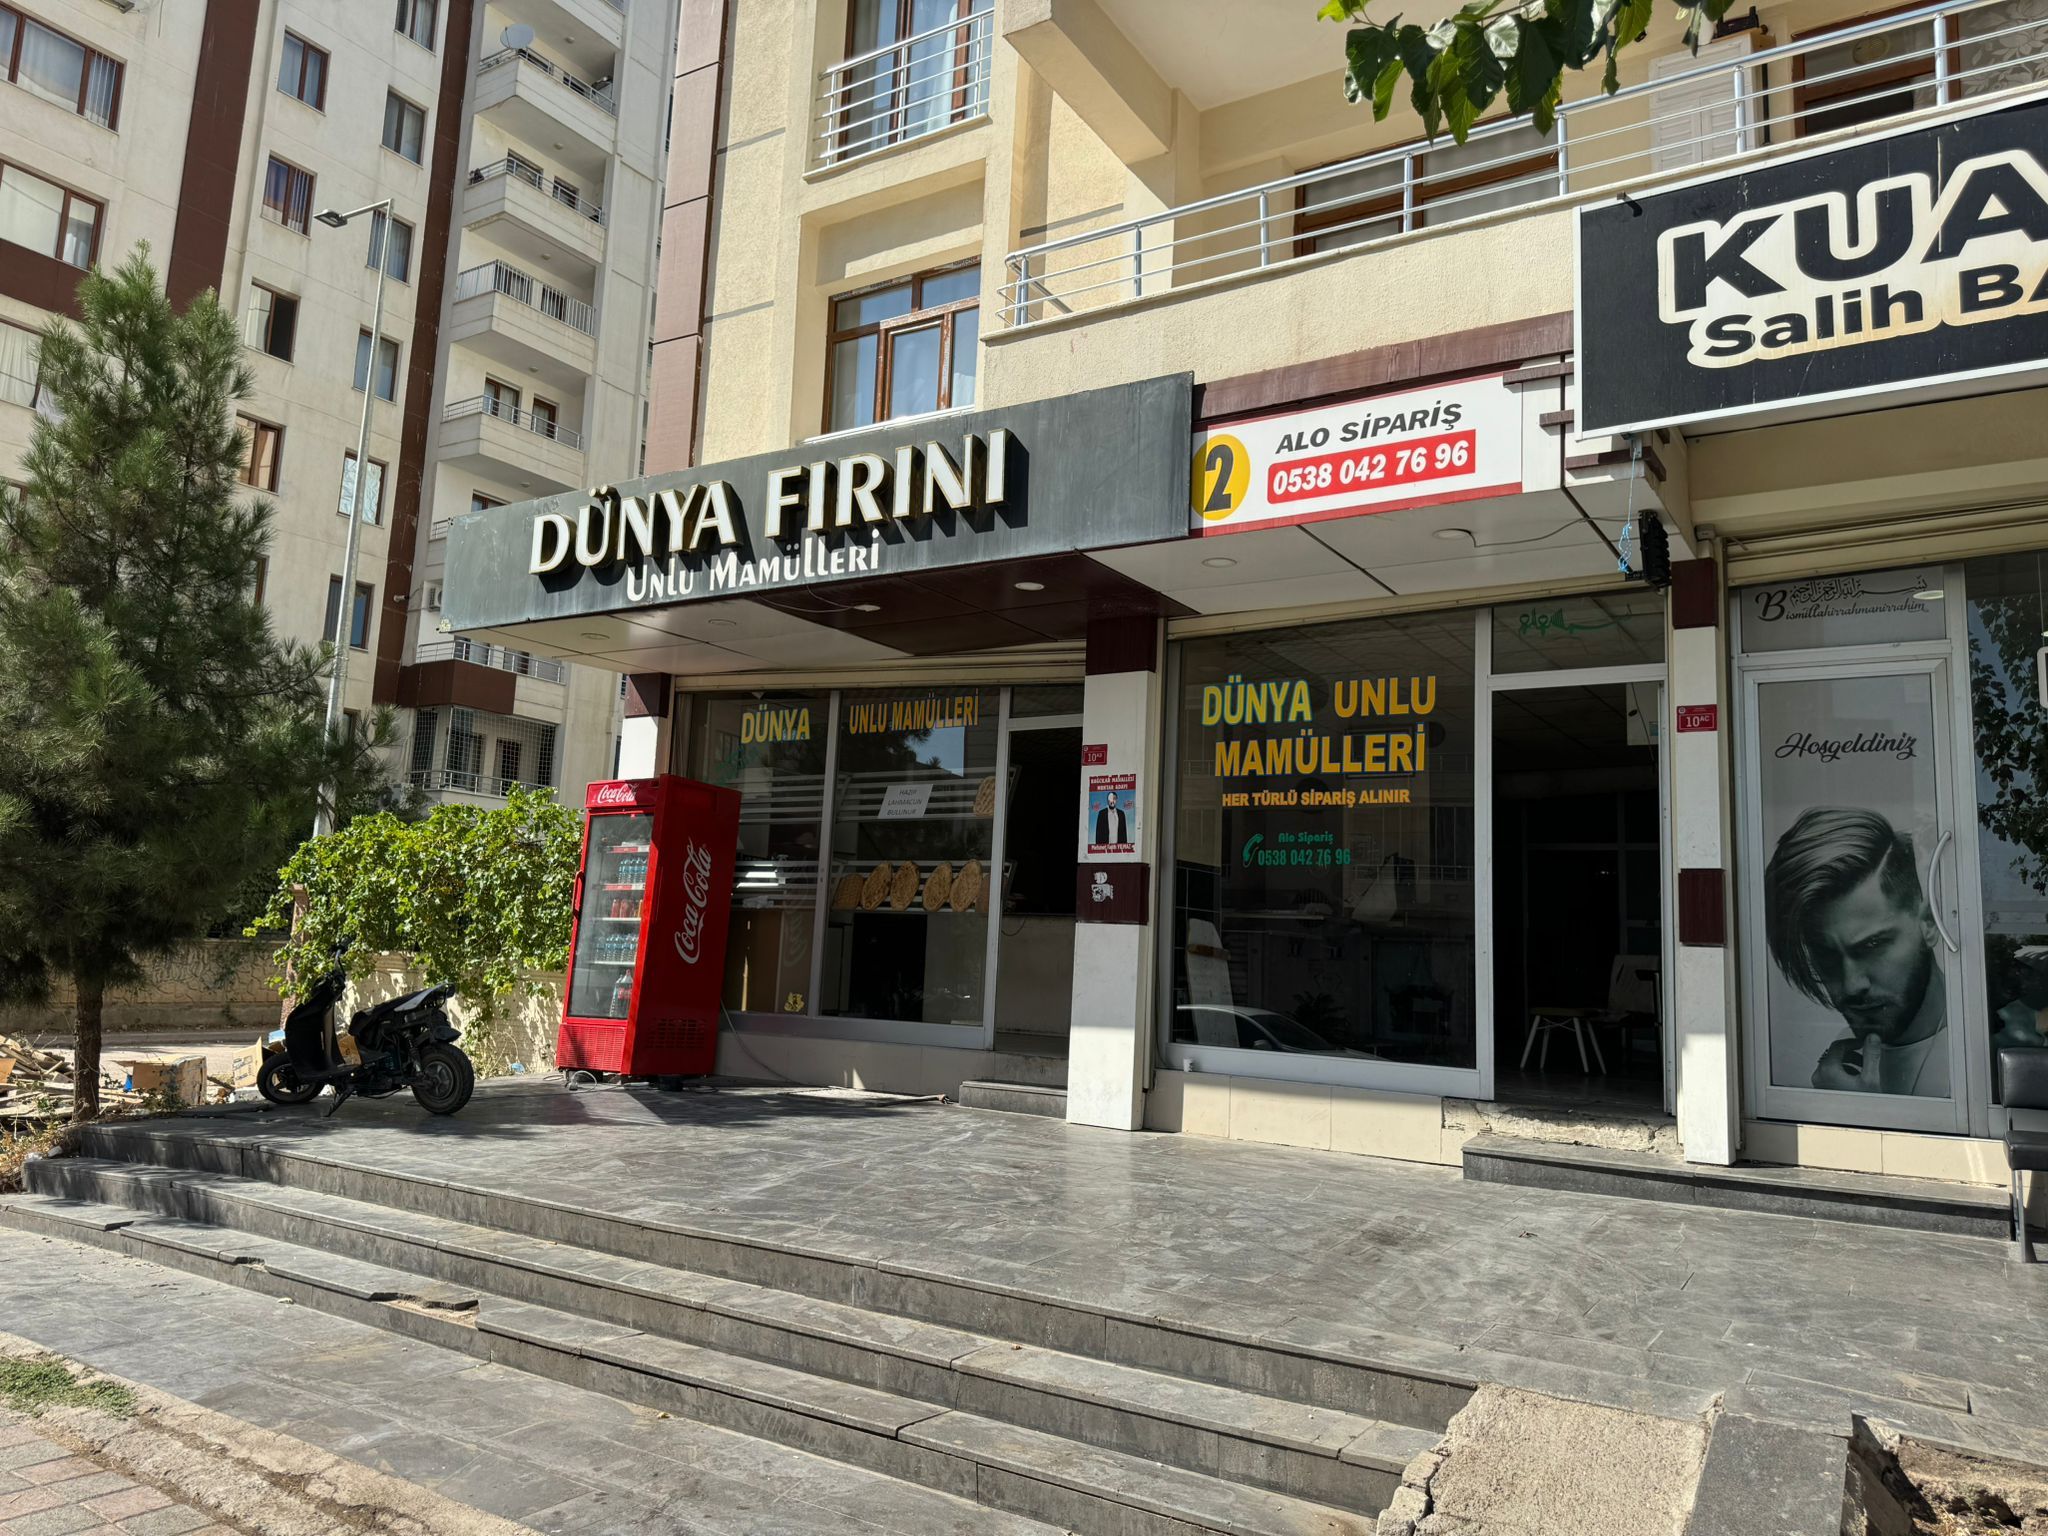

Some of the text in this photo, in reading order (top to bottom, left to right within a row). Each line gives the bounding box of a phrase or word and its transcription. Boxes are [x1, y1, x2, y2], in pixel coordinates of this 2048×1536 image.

[1704, 263, 2048, 357] Salih B
[1275, 400, 1463, 455] ALO SİPARİŞ
[1203, 444, 1234, 512] 2
[1273, 440, 1469, 495] 0538 042 76 96
[529, 428, 1012, 575] DÜNYA FIRINI
[1755, 588, 1929, 622] Bismillahirrahmanirrahim
[741, 688, 979, 744] DÜNYA UNLU MAMÜLLERİ
[1202, 675, 1436, 726] DÜNYA UNLU
[1214, 724, 1425, 777] MAMÜLLERİ
[1222, 788, 1410, 808] HER TÜRLÜ SİPARİŞ ALINIR
[1258, 849, 1287, 866] 0538
[1290, 848, 1313, 866] 042
[1335, 848, 1351, 865] 96
